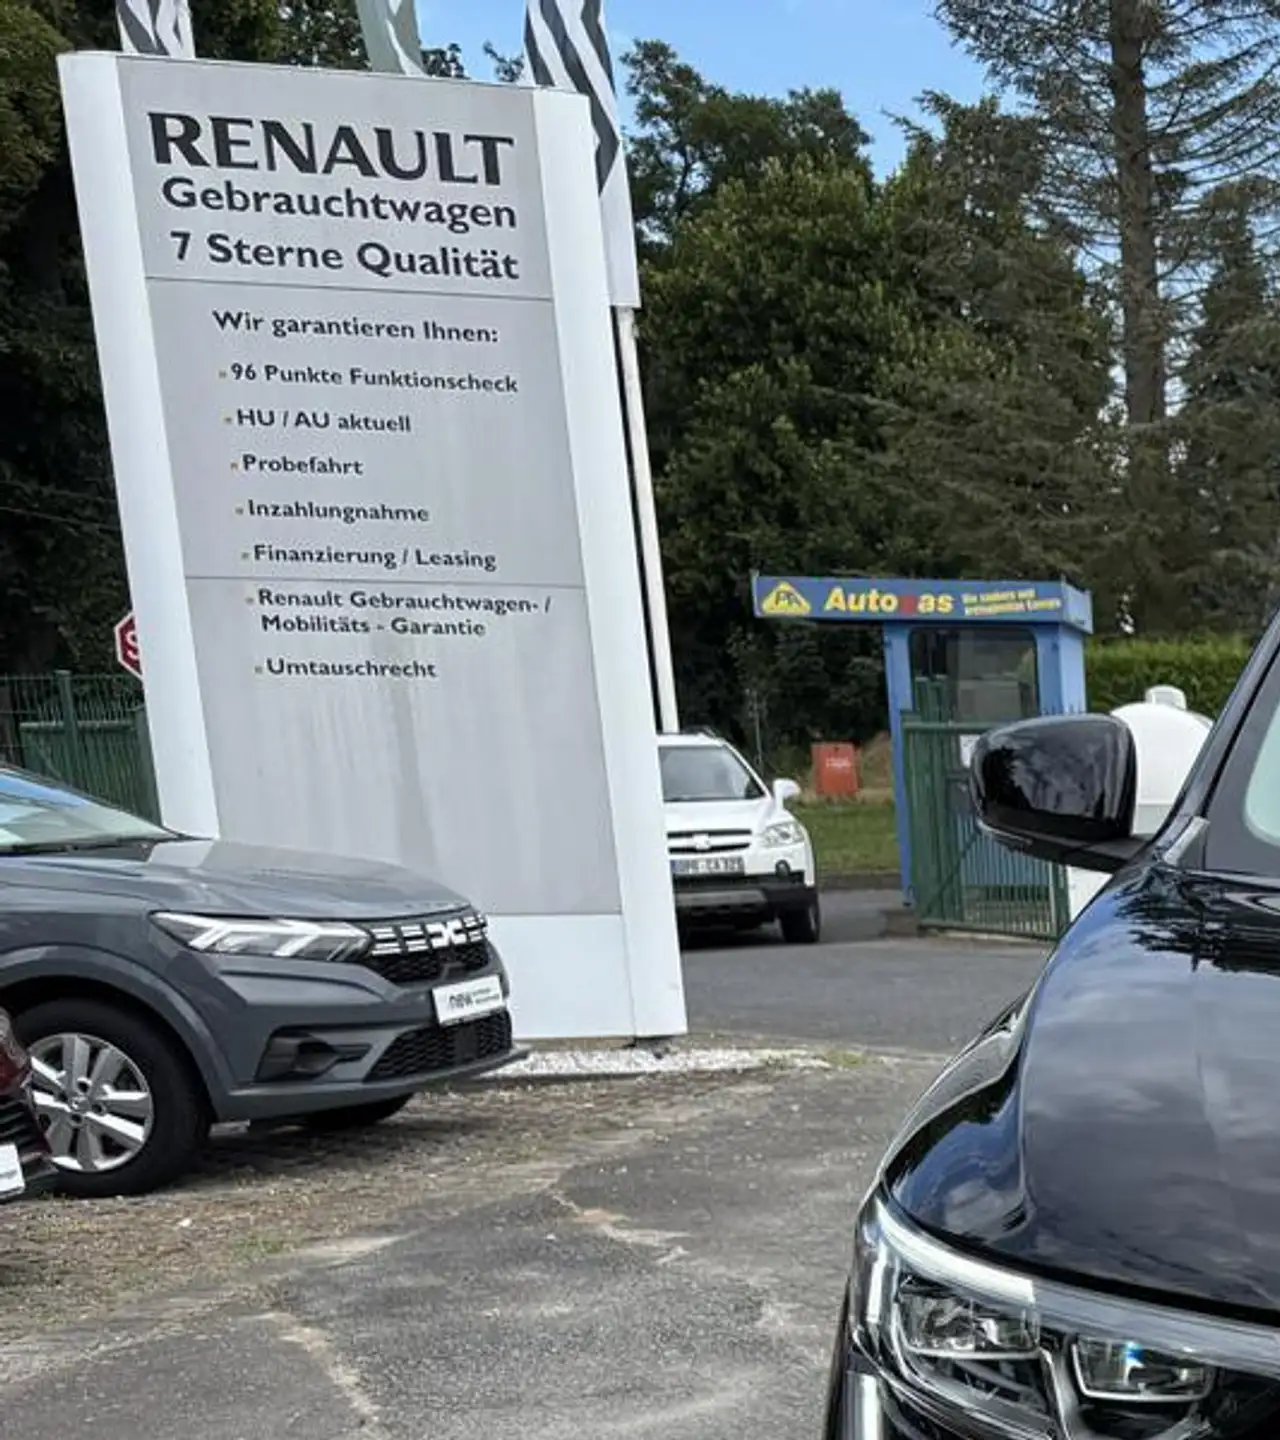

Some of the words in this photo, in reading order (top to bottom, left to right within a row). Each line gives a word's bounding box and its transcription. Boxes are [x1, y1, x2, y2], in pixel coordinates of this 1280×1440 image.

[147, 112, 514, 186] RENAULT
[163, 177, 516, 233] Gebrauchtwagen
[171, 231, 190, 262] 7
[208, 232, 343, 270] Sterne
[357, 241, 519, 280] Qualität
[213, 310, 265, 332] Wir
[272, 314, 415, 342] garantieren
[424, 321, 499, 344] Ihnen:
[231, 363, 256, 381] 96
[265, 364, 342, 386] Punkte
[350, 367, 518, 394] Funktionscheck
[236, 409, 275, 427] HU
[294, 411, 330, 429] AU
[338, 413, 411, 433] aktuell
[242, 454, 364, 476] Probefahrt
[248, 499, 429, 524] Inzahlungnahme
[253, 544, 398, 570] Finanzierung
[415, 549, 497, 572] Leasing
[257, 589, 343, 609] Renault
[261, 614, 370, 634] Mobilitäts
[390, 618, 486, 637] Garantie
[266, 657, 437, 678] Umtauschrecht
